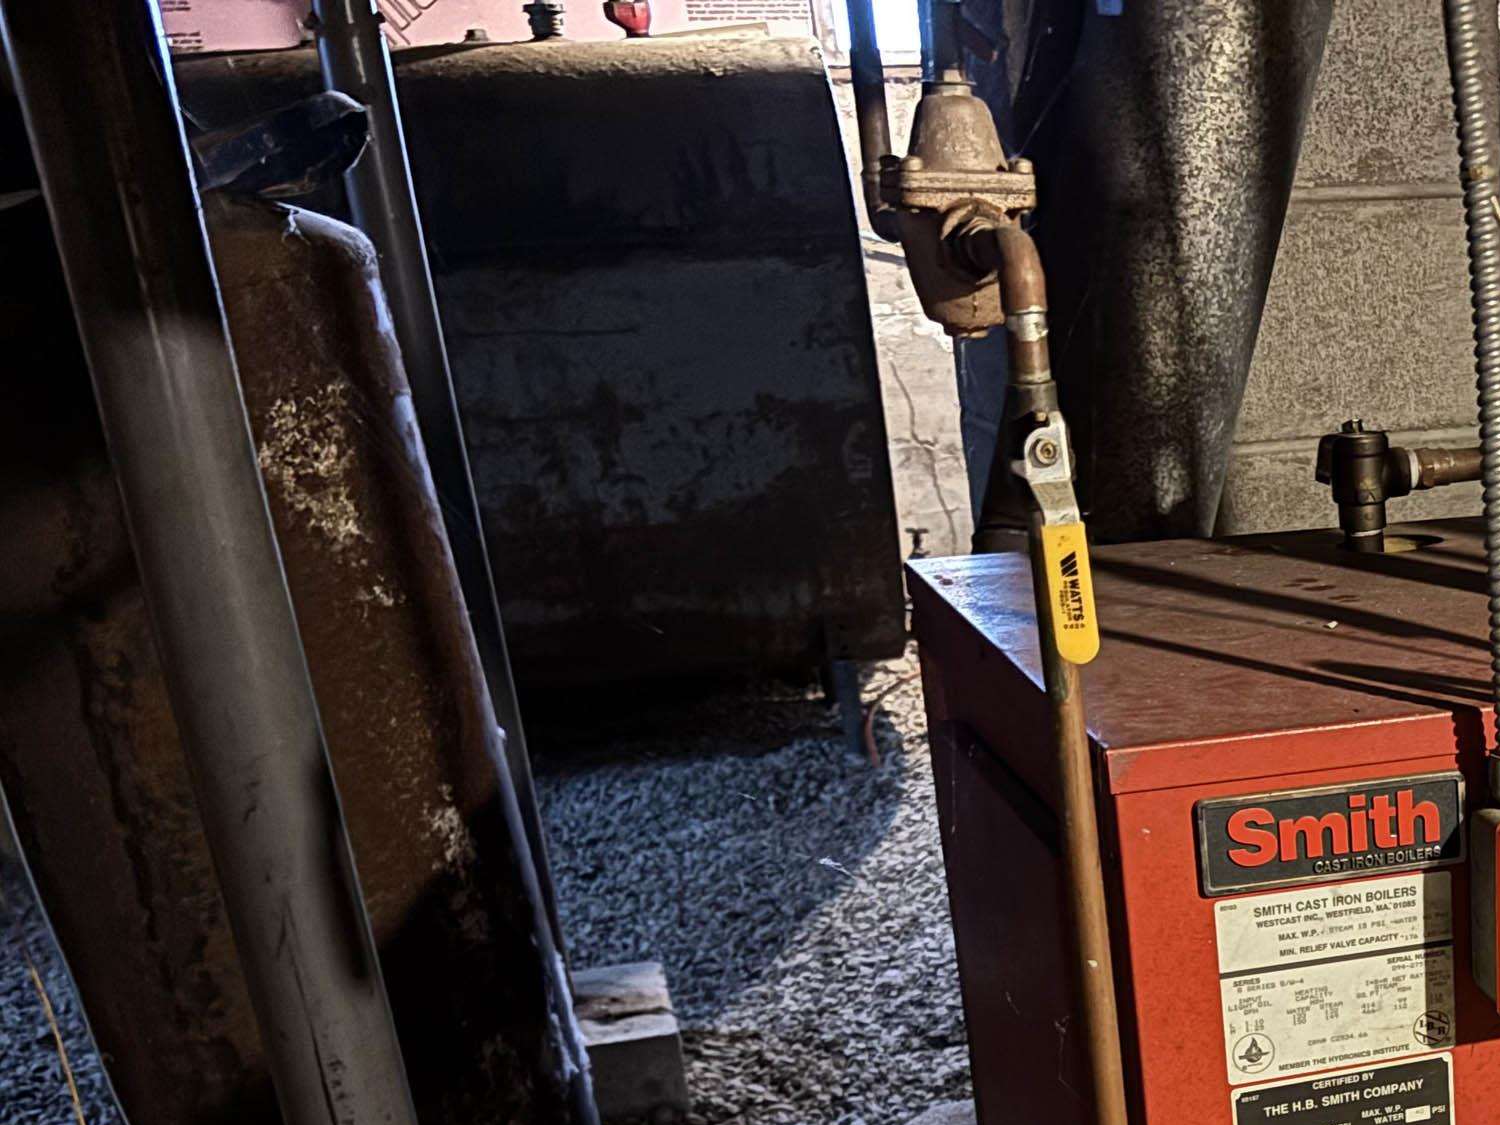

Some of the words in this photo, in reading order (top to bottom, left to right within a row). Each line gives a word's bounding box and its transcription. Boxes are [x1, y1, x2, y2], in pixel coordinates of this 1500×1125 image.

[1069, 579, 1085, 621] WATTS
[1227, 789, 1441, 868] Smith
[1314, 858, 1349, 873] CAST
[1352, 854, 1384, 869] IRON
[1386, 845, 1441, 864] BOILERS
[1253, 902, 1292, 918] SMITH
[1296, 897, 1328, 912] CAST
[1332, 893, 1362, 907] IRON
[1365, 886, 1417, 902] BOILERS
[1256, 914, 1302, 928] WESTCAST
[1325, 905, 1375, 919] WESTFIELD,
[1376, 903, 1391, 911] MA.
[1393, 899, 1416, 910] 01085
[1278, 931, 1299, 942] MAX.
[1301, 929, 1320, 938] W.P.
[1279, 947, 1297, 957] MIN.
[1299, 942, 1328, 954] RELIEF
[1330, 938, 1357, 949] VALVE
[1358, 933, 1399, 945] CAPACITY
[1387, 954, 1413, 964] SERIAL
[1233, 978, 1260, 988] SERIES
[1279, 1060, 1310, 1071] MEMBER
[1312, 1056, 1327, 1065] THE
[1329, 1048, 1371, 1061] HYDRONICS
[1373, 1043, 1409, 1055] INSTITUTE
[1312, 1074, 1360, 1090] CERTIFIED
[1362, 1072, 1375, 1081] BY
[1264, 1103, 1289, 1117] THE
[1292, 1099, 1318, 1112] H.B.
[1322, 1090, 1360, 1106] SMITH
[1363, 1079, 1424, 1099] COMPANY
[1361, 1108, 1382, 1118] MAX.
[1384, 1104, 1403, 1114] W.P.
[1374, 1112, 1404, 1124] WATER
[1432, 1105, 1446, 1114] PSI
